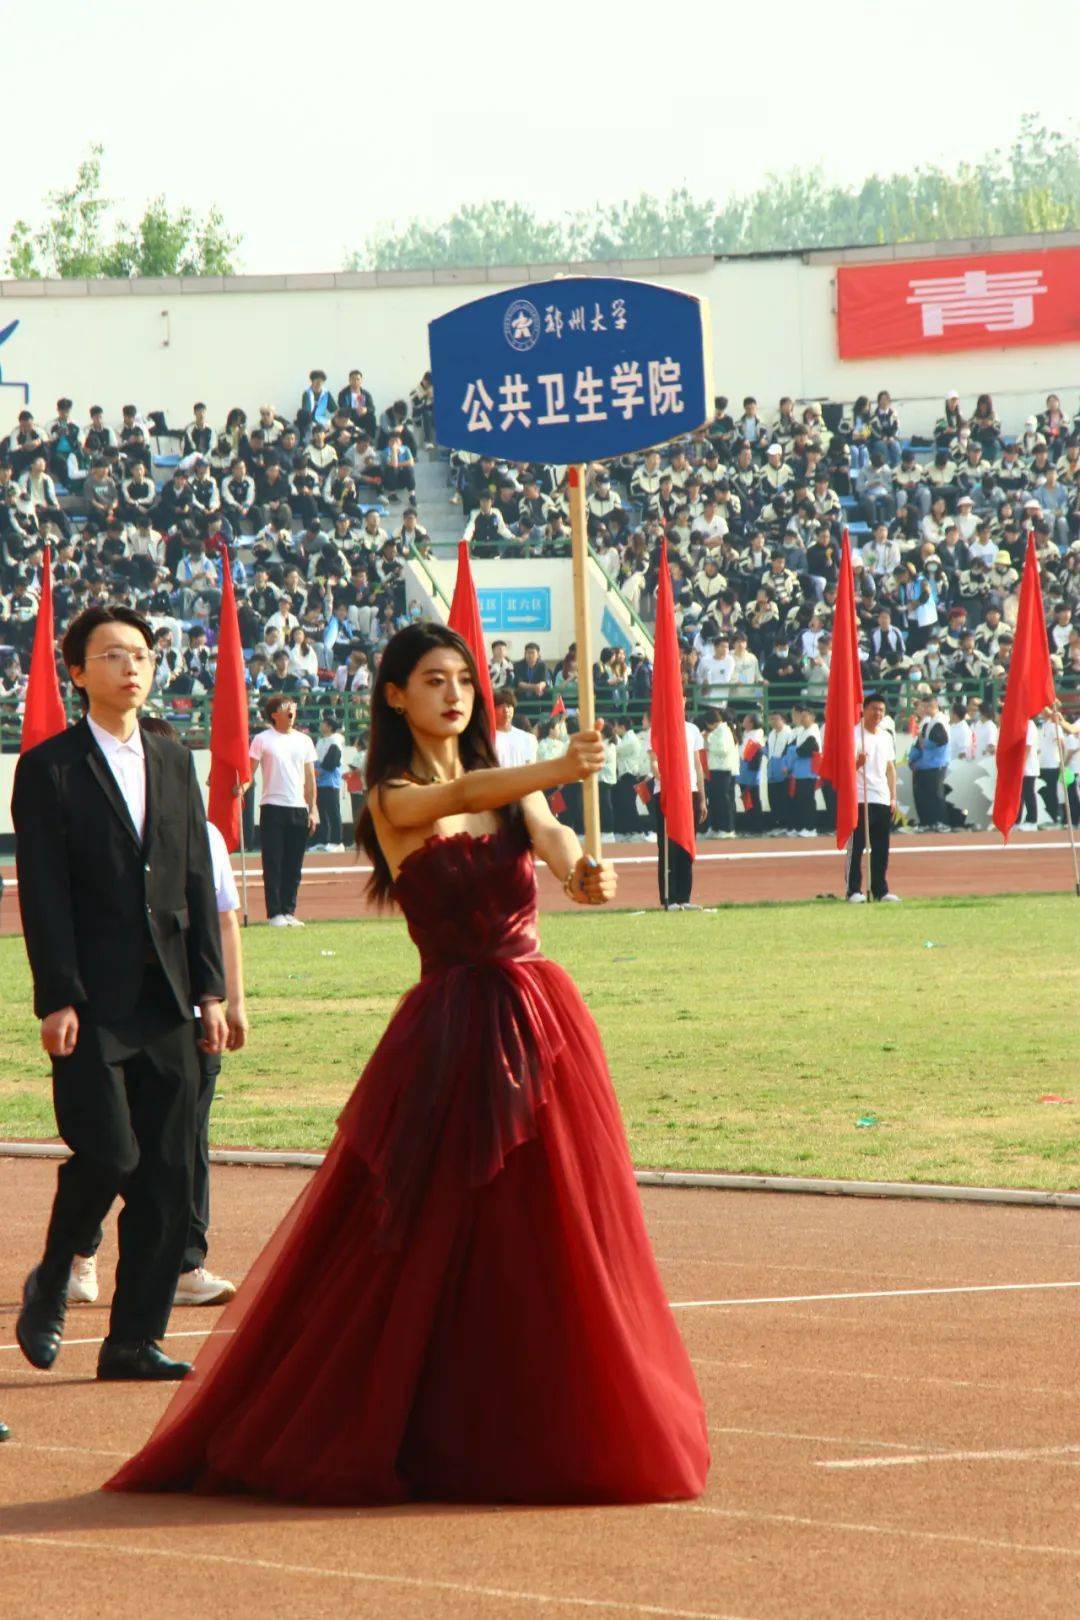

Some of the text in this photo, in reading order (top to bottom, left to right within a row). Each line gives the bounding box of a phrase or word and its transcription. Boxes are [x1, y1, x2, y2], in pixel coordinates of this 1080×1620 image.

[461, 357, 685, 432] 公共卫生学院
